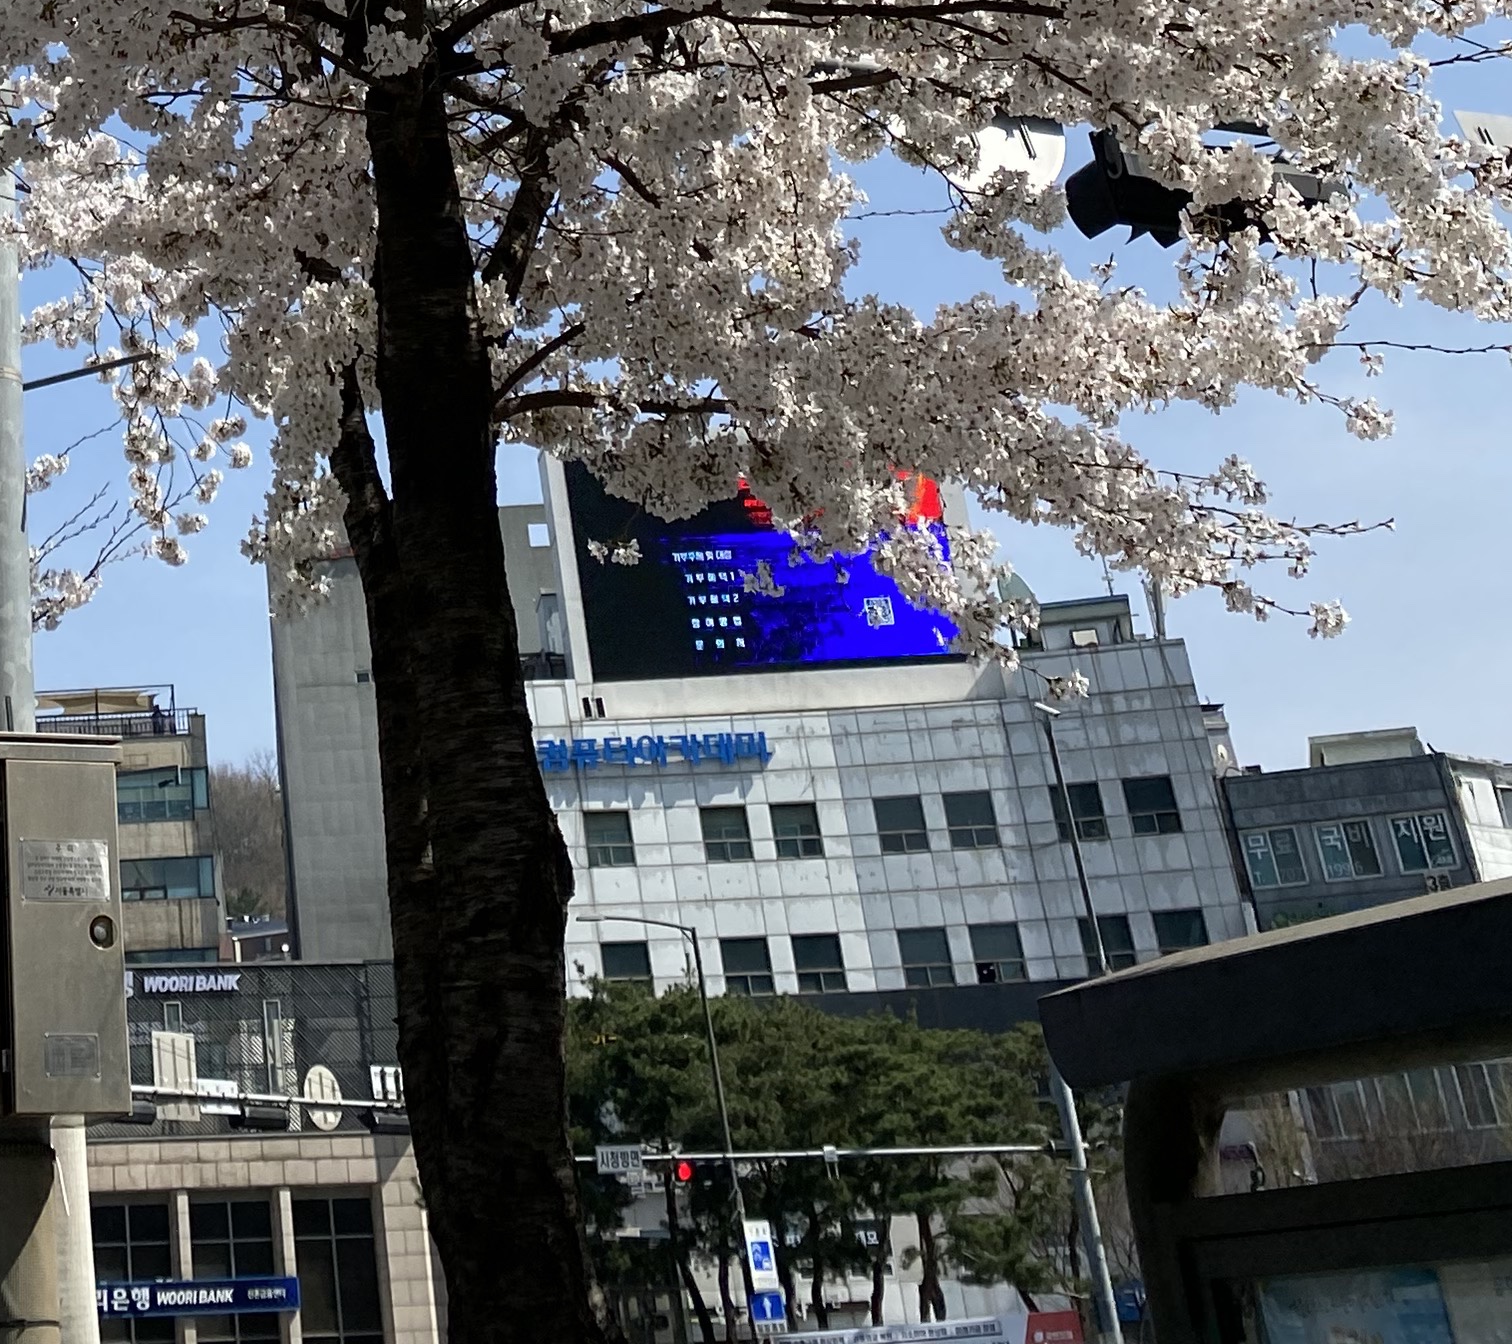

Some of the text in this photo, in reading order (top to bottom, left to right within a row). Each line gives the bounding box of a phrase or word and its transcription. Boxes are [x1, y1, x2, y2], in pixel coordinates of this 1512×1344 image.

[536, 731, 773, 773] 컴퓨터아카데미
[1248, 813, 1448, 860] 무료 국비 지원
[143, 975, 193, 993] WOORI
[195, 973, 241, 993] BANK
[600, 1149, 640, 1170] 시청방면
[97, 1286, 150, 1312] 리은행
[157, 1290, 197, 1307] WOORI
[199, 1288, 234, 1304] BANK
